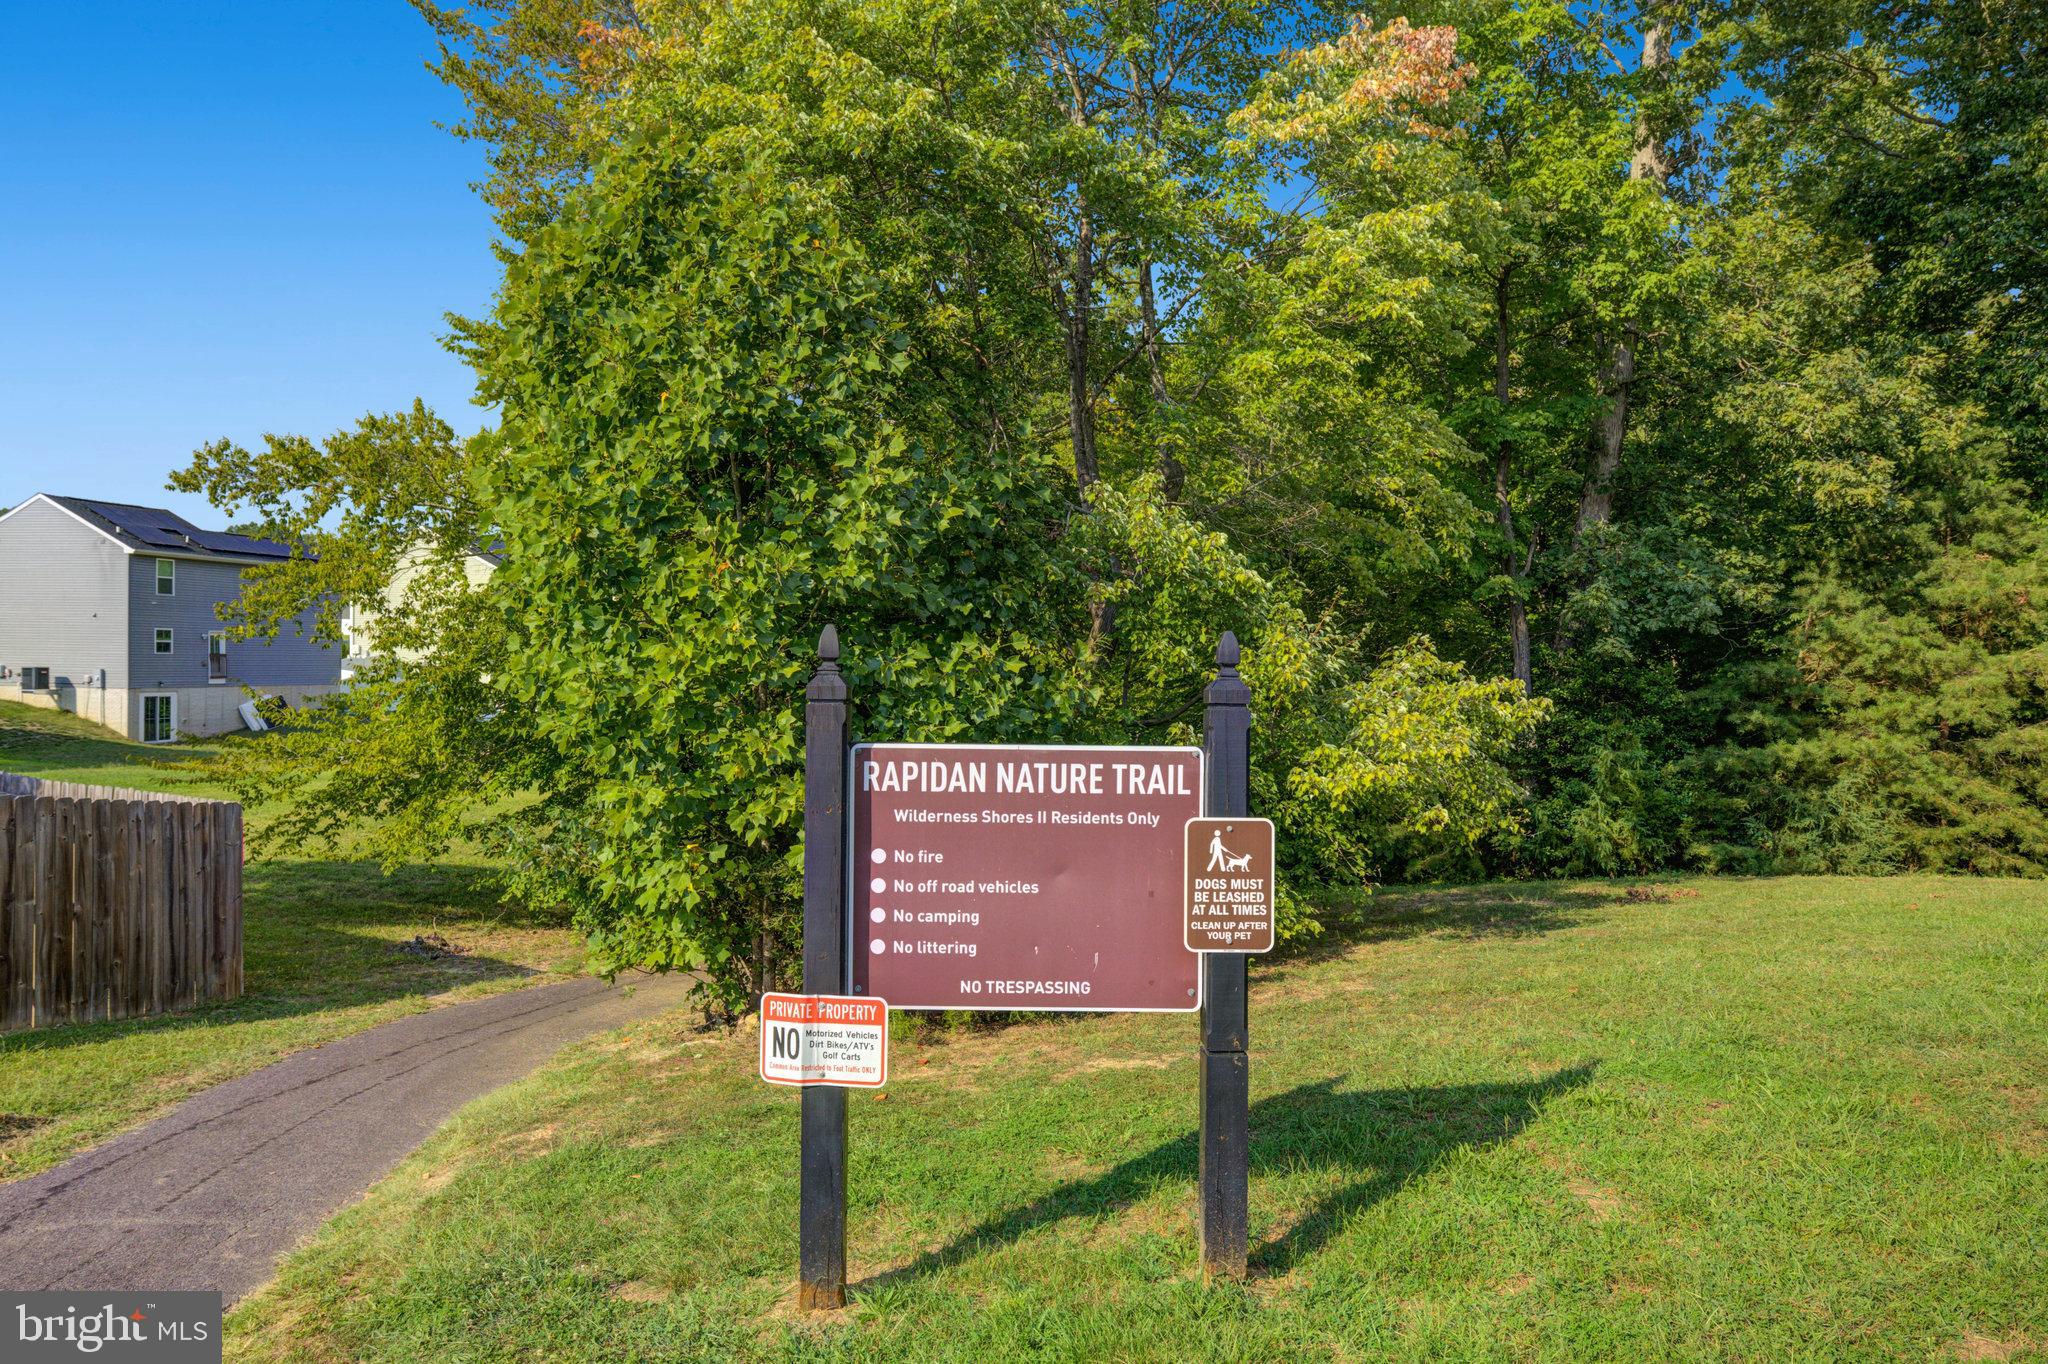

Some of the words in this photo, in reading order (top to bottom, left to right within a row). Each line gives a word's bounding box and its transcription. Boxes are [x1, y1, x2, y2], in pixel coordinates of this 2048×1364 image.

[863, 760, 987, 793] RAPIDAN
[996, 762, 1103, 794] NATURE
[1112, 763, 1191, 795] TRAIL
[894, 809, 978, 823] Wilderness
[981, 810, 1033, 824] Shores
[1038, 811, 1047, 824] II
[1051, 811, 1124, 825] Residents
[1127, 812, 1160, 828] Only
[894, 850, 915, 863] No
[917, 849, 943, 863] fire
[894, 880, 914, 893] No
[918, 880, 939, 893] off
[942, 880, 975, 894] road
[978, 880, 1039, 894] vehicles
[1195, 879, 1227, 890] DOGS
[1231, 879, 1264, 890] MUST
[1194, 892, 1210, 902] BE
[1213, 892, 1265, 902] LEASHED
[1192, 905, 1206, 915] AT
[1208, 905, 1229, 915] ALL
[1232, 905, 1267, 916] TIMES
[893, 909, 913, 922] No
[917, 910, 980, 926] camping
[1191, 922, 1220, 930] CLEAN
[1223, 922, 1236, 930] UP
[1238, 922, 1267, 930] AFTER
[1207, 932, 1232, 940] YOUR
[1234, 932, 1252, 940] PET
[893, 941, 913, 954] No
[917, 940, 977, 957] littering
[960, 980, 982, 994] NO
[985, 981, 1091, 995] TRESPASSING
[769, 1001, 813, 1019] PRIVATE
[818, 1003, 877, 1021] PROPERTY
[805, 1030, 843, 1038] Motorized
[846, 1031, 878, 1040] Vehicles
[773, 1026, 800, 1060] NO
[827, 1042, 874, 1051] Bikes/ATV's
[822, 1052, 838, 1060] Golf
[841, 1053, 861, 1061] Carts
[861, 1066, 876, 1074] ONLY
